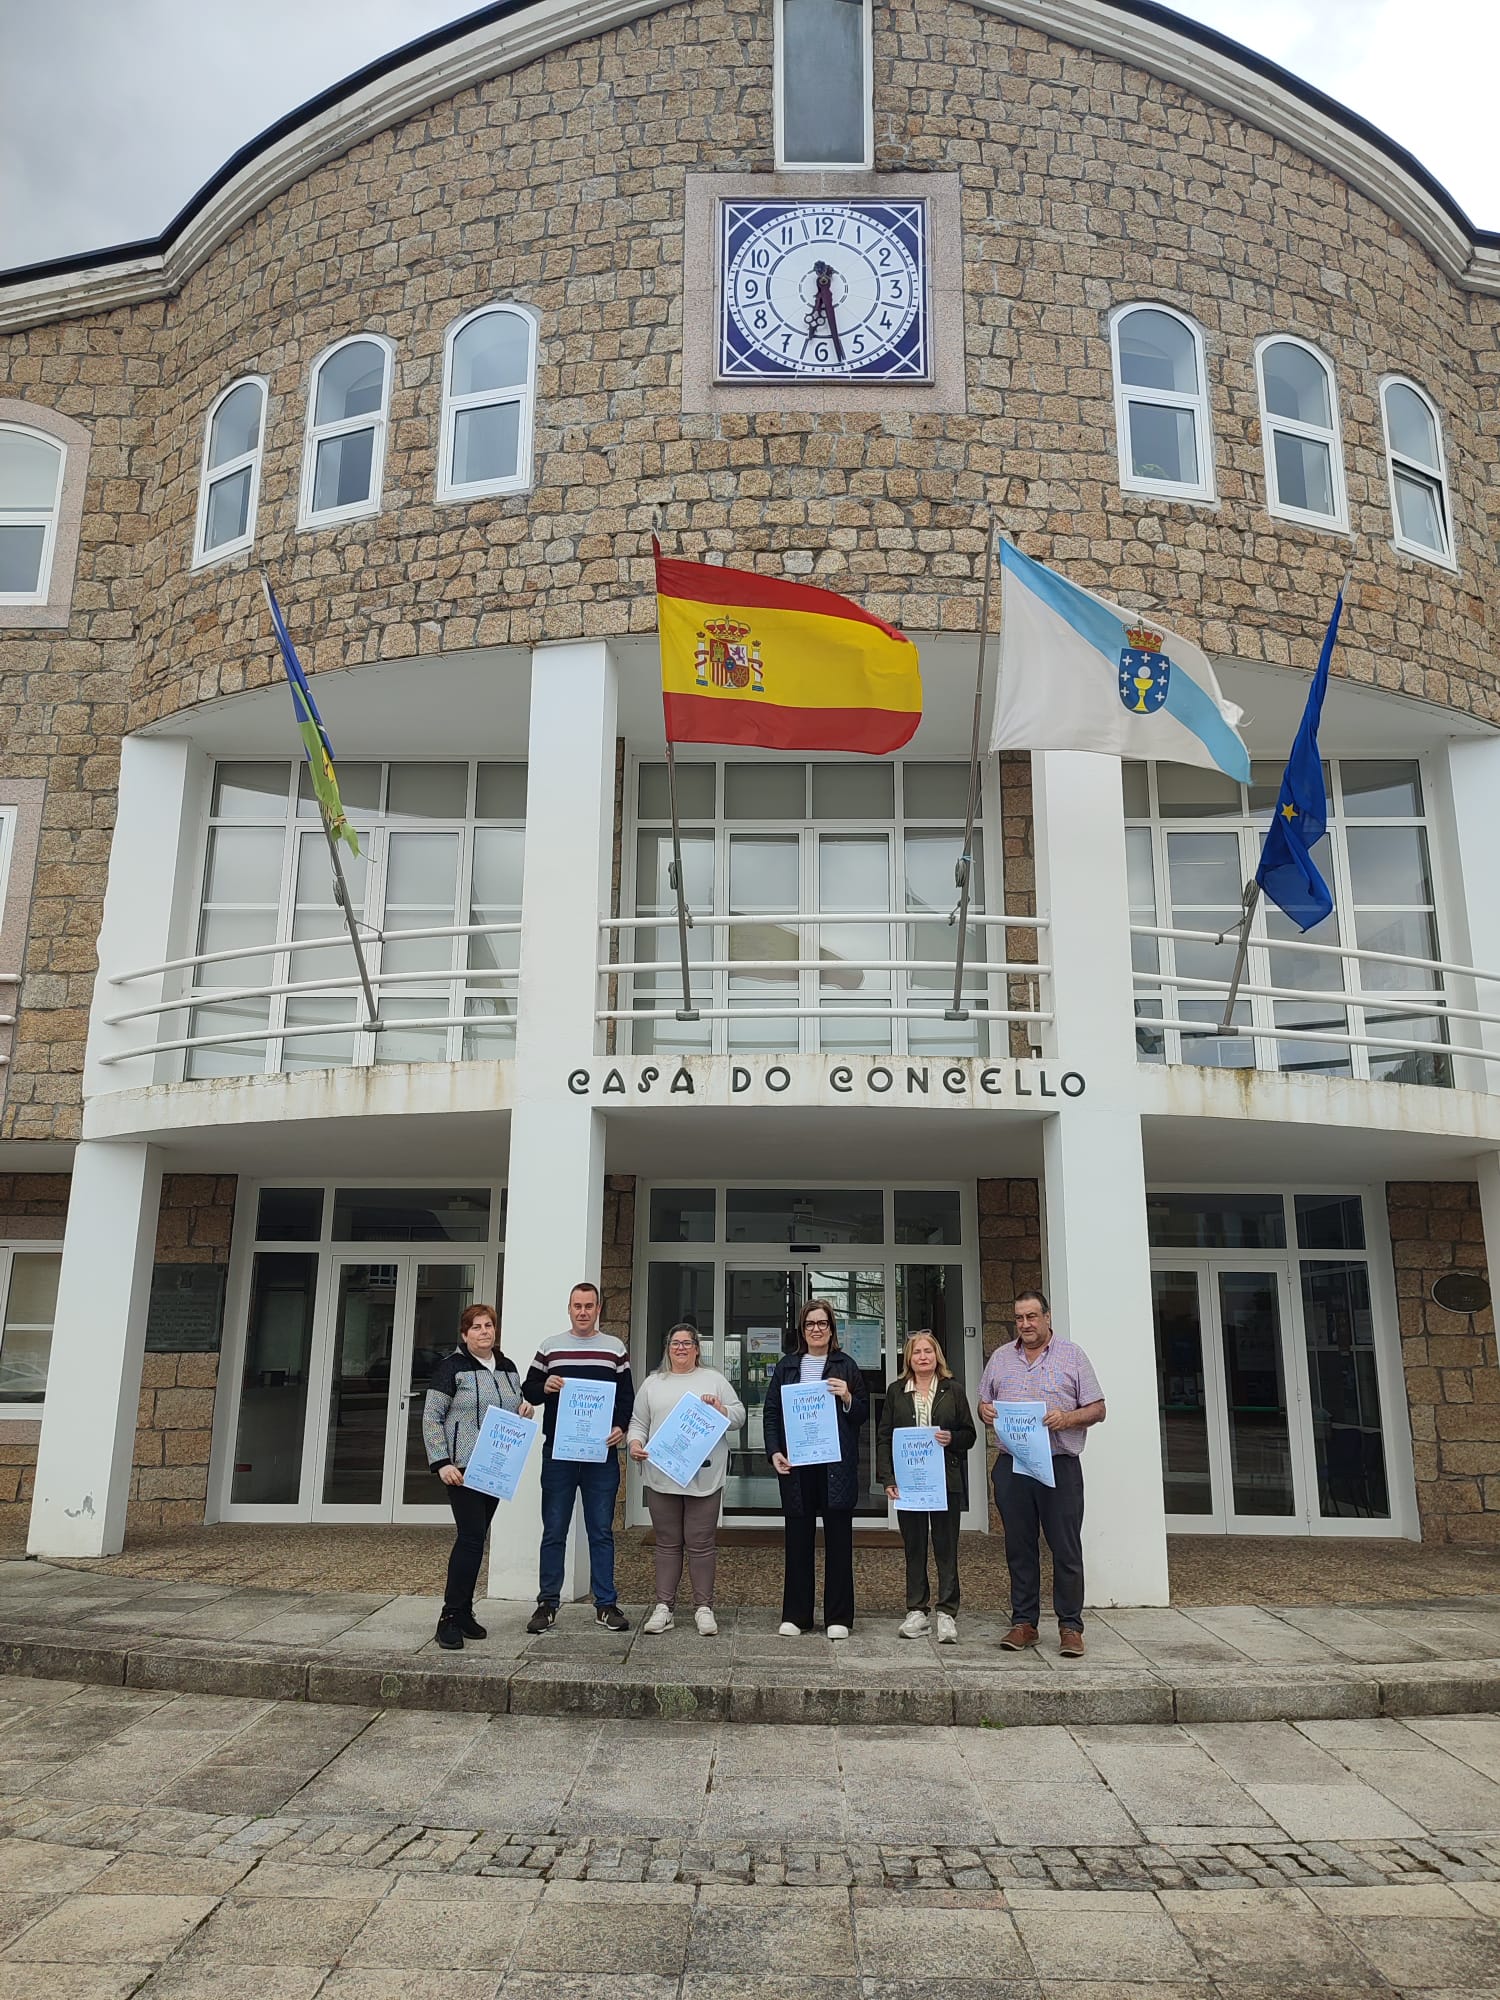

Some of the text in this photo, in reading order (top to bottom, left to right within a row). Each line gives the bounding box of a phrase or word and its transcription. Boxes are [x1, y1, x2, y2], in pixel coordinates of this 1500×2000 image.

[781, 226, 793, 245] 11
[815, 217, 834, 236] 12
[856, 226, 861, 244] 1
[751, 249, 770, 268] 10
[879, 247, 891, 267] 2
[744, 279, 759, 299] 9
[890, 279, 903, 299] 3
[754, 309, 767, 329] 8
[880, 311, 893, 330] 4
[780, 333, 793, 353] 7
[814, 341, 829, 362] 6
[852, 334, 865, 354] 5
[567, 1065, 1087, 1099] CASA DO CONCELLO
